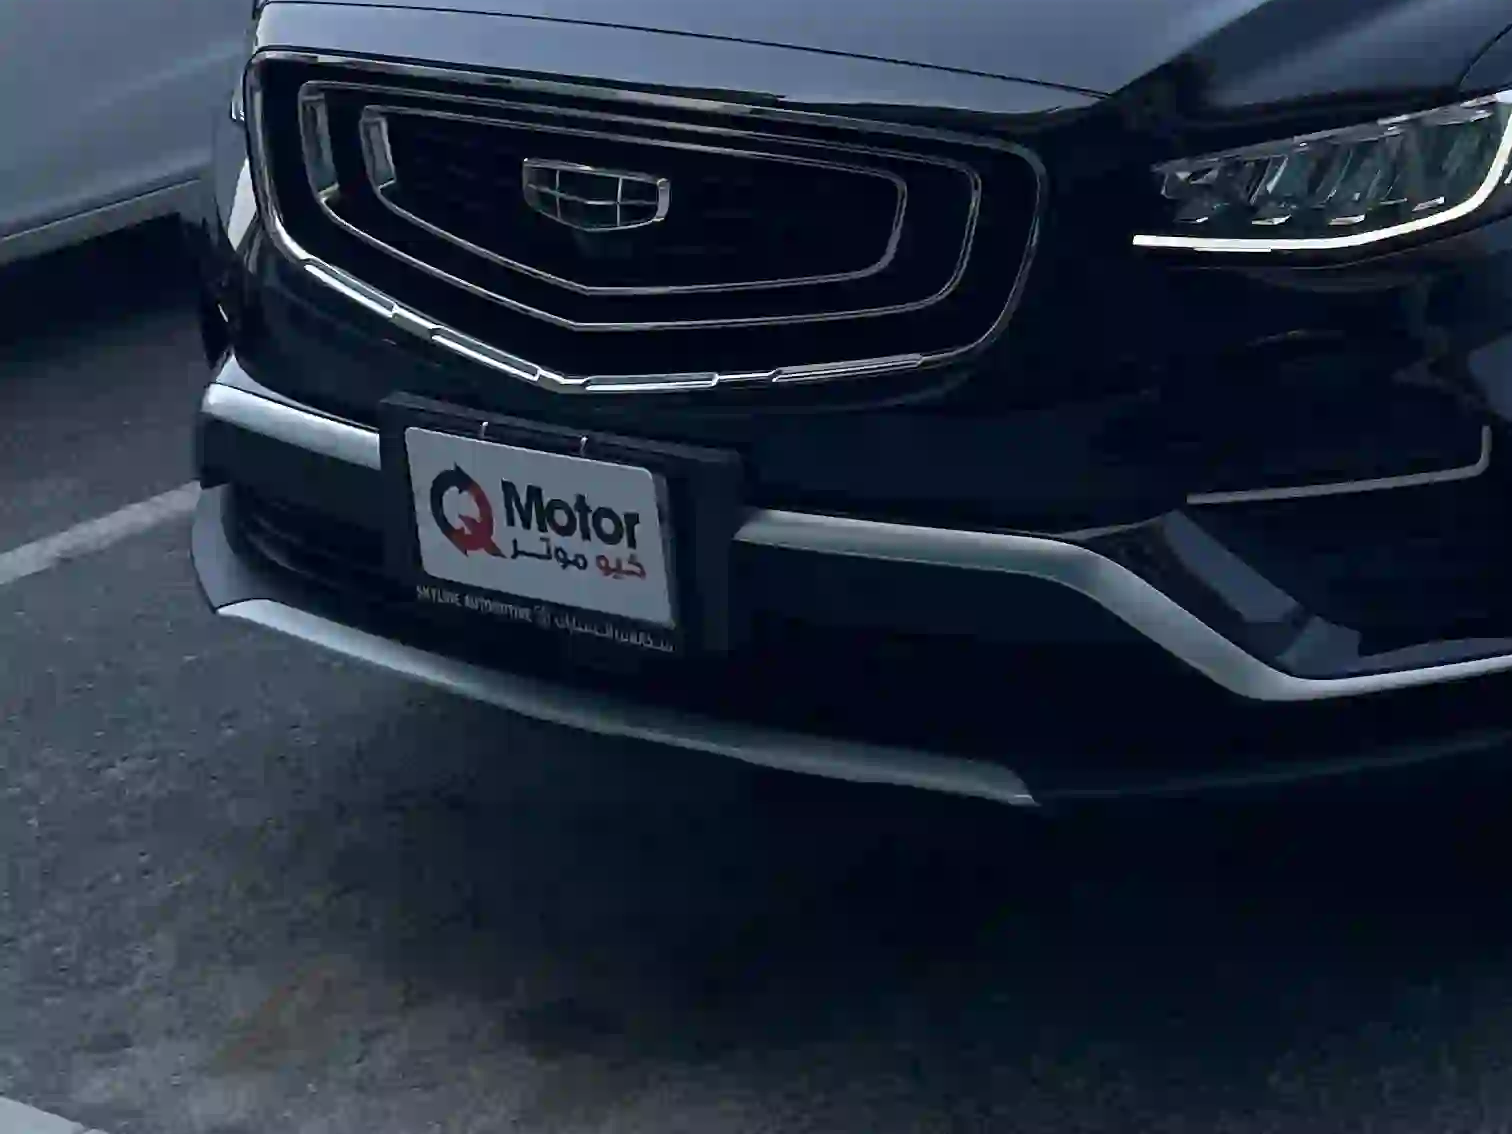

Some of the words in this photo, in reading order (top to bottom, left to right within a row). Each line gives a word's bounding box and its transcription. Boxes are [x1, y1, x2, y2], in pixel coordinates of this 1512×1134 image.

[430, 462, 507, 559] Q
[501, 477, 640, 549] Motor
[416, 584, 463, 607] SKYLINE
